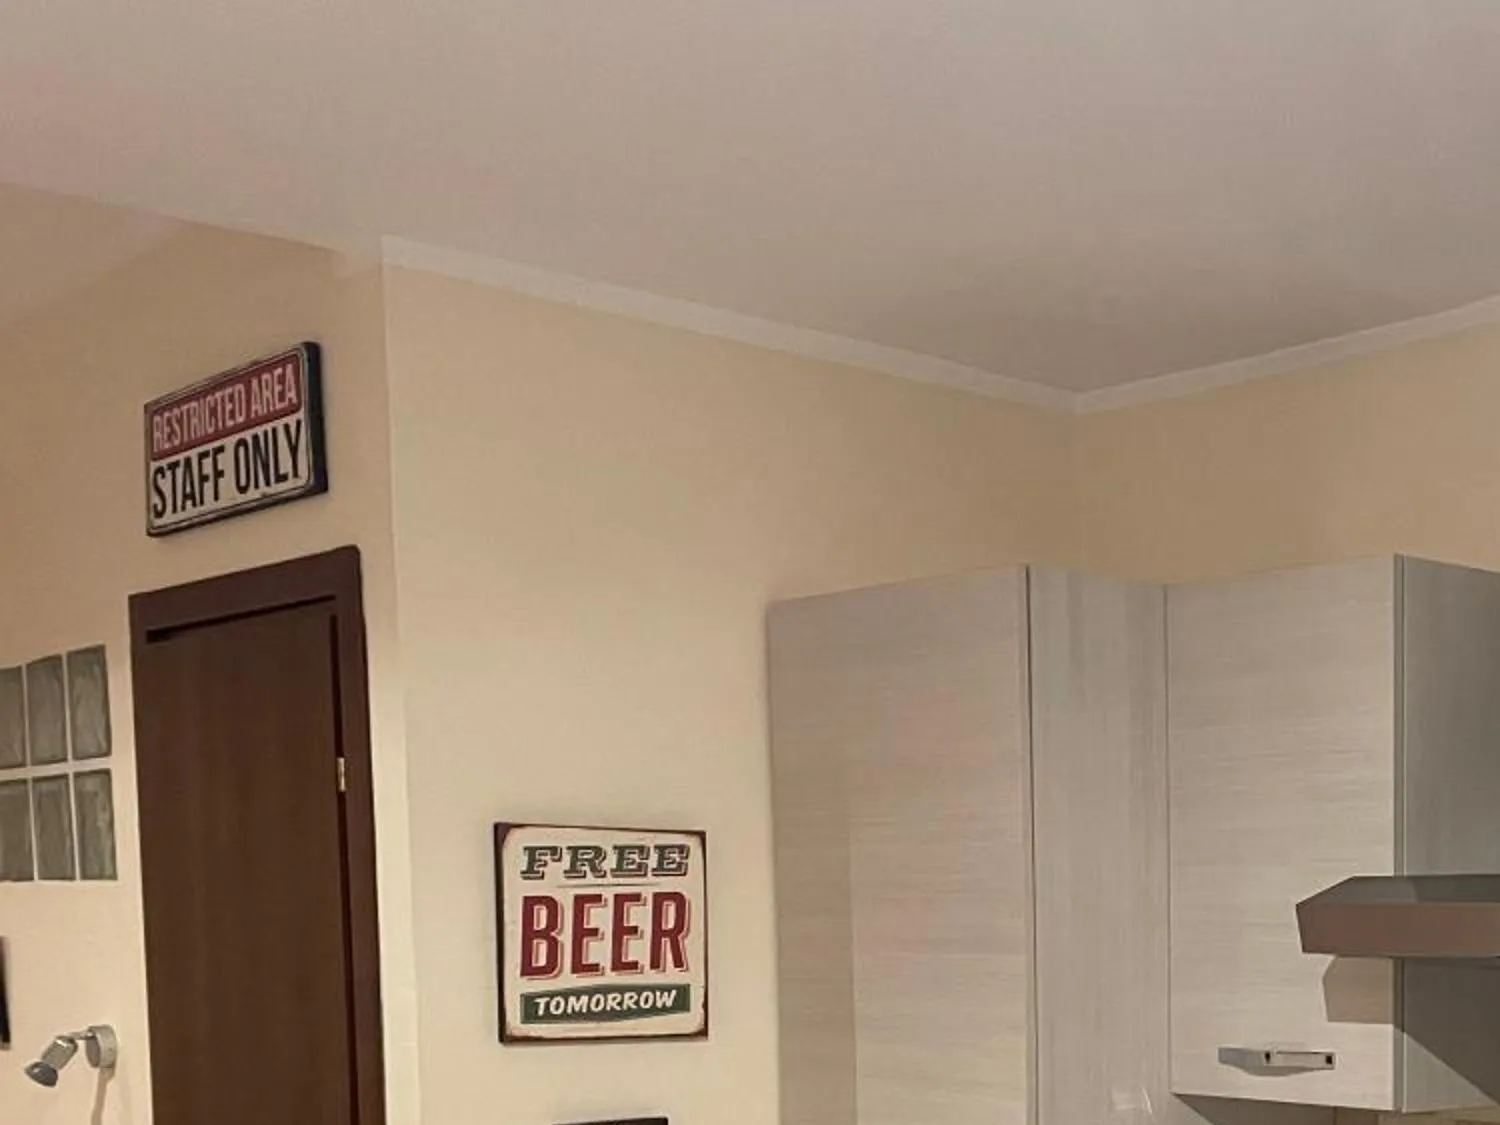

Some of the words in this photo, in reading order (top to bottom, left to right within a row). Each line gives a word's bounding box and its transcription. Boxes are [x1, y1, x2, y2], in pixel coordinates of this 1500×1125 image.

[153, 383, 246, 452] RESTRICTED
[250, 363, 298, 419] AREA
[152, 444, 225, 518] STAFF
[233, 419, 302, 494] ONLY
[519, 844, 691, 880] FREE
[519, 891, 692, 980] BEER
[533, 989, 678, 1017] TOMORROW
